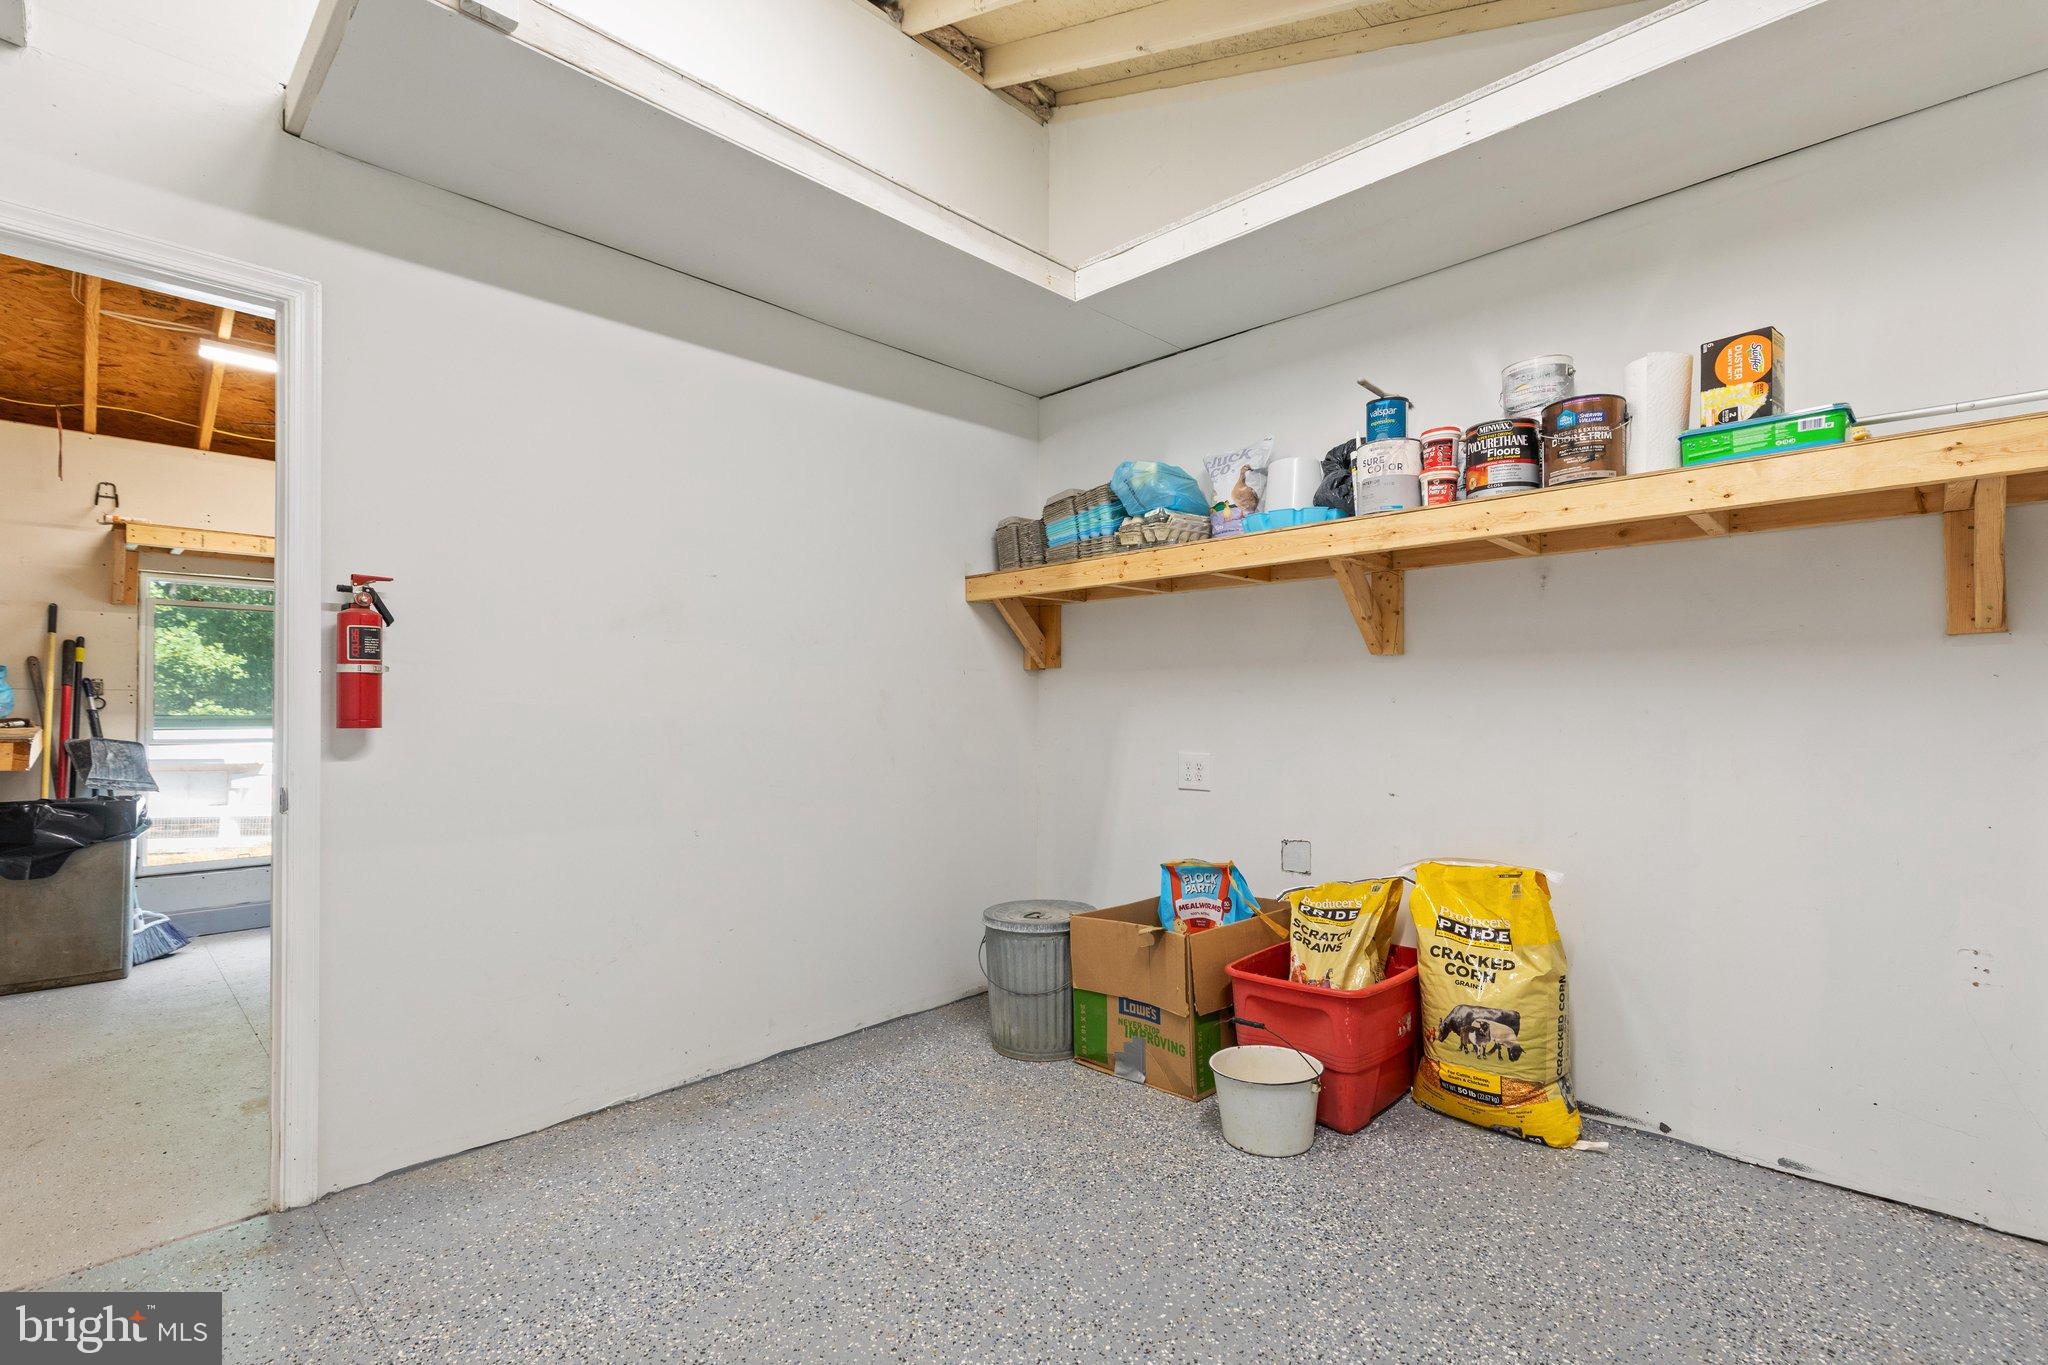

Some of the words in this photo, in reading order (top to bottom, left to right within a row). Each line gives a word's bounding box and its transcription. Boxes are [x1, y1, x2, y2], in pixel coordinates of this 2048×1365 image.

[1734, 344, 1743, 379] DUSTER
[1749, 342, 1763, 372] Swiffer
[1370, 407, 1397, 418] valspar
[1480, 421, 1511, 434] MINWAX
[1588, 431, 1613, 441] TRIM
[1467, 434, 1529, 455] POLYURETHANE
[1487, 447, 1521, 458] Floors
[1362, 455, 1385, 468] SURE
[1367, 462, 1404, 475] COLOR
[1183, 873, 1219, 886] FLOCK
[1185, 884, 1216, 895] PARTY
[1178, 902, 1221, 912] MEALWORMS
[1301, 894, 1362, 909] Producer's
[1300, 905, 1359, 920] PRIDE
[1292, 917, 1353, 942] SCRATCH
[1438, 918, 1510, 942] PRIDE
[1292, 930, 1343, 953] GRAINS
[1430, 945, 1516, 971] CRACKED
[1445, 962, 1497, 984] CORN
[1558, 975, 1567, 1012] CORN
[1123, 999, 1157, 1020] LOWE'S
[1118, 1017, 1142, 1030] NEVER
[1124, 1025, 1186, 1057] IMPROVING
[1556, 1014, 1565, 1076] CRACKED
[1457, 1086, 1468, 1096] 50
[1468, 1090, 1477, 1098] lb
